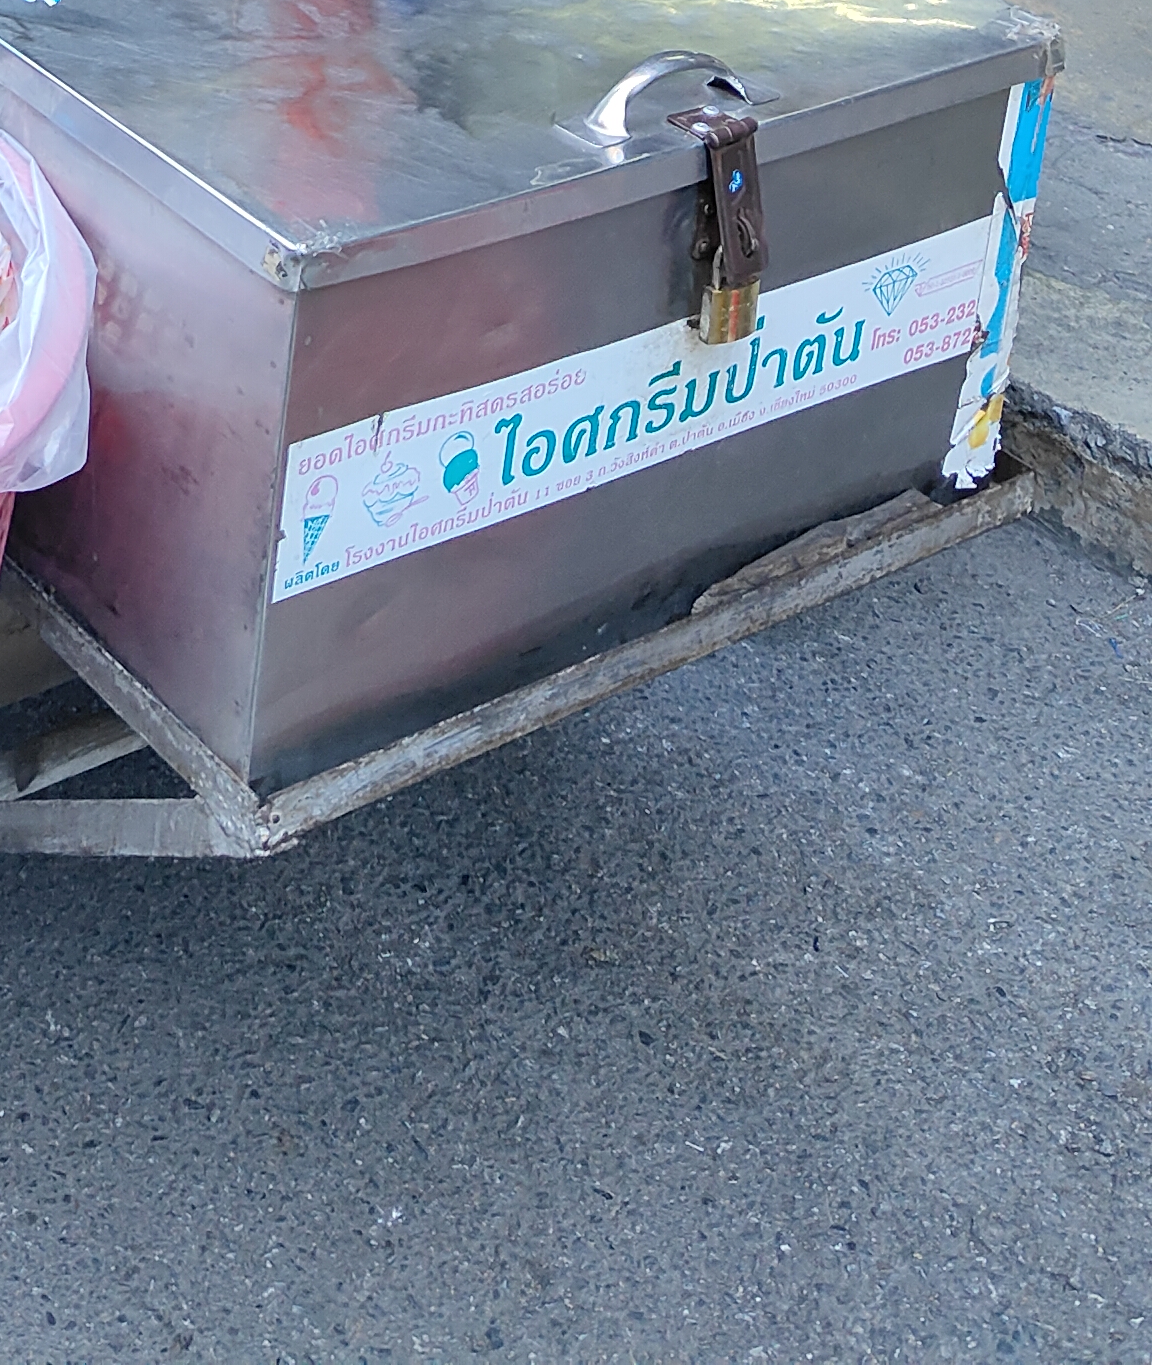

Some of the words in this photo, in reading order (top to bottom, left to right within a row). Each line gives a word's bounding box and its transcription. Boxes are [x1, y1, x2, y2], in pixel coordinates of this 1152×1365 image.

[494, 305, 866, 487] ไอศกรีมป่าตัน
[902, 325, 973, 367] 053-872
[283, 555, 340, 590] ผลิตโดย
[344, 484, 529, 569] โรงงานไอศกรีมป่าตัน
[818, 372, 857, 395] 50300
